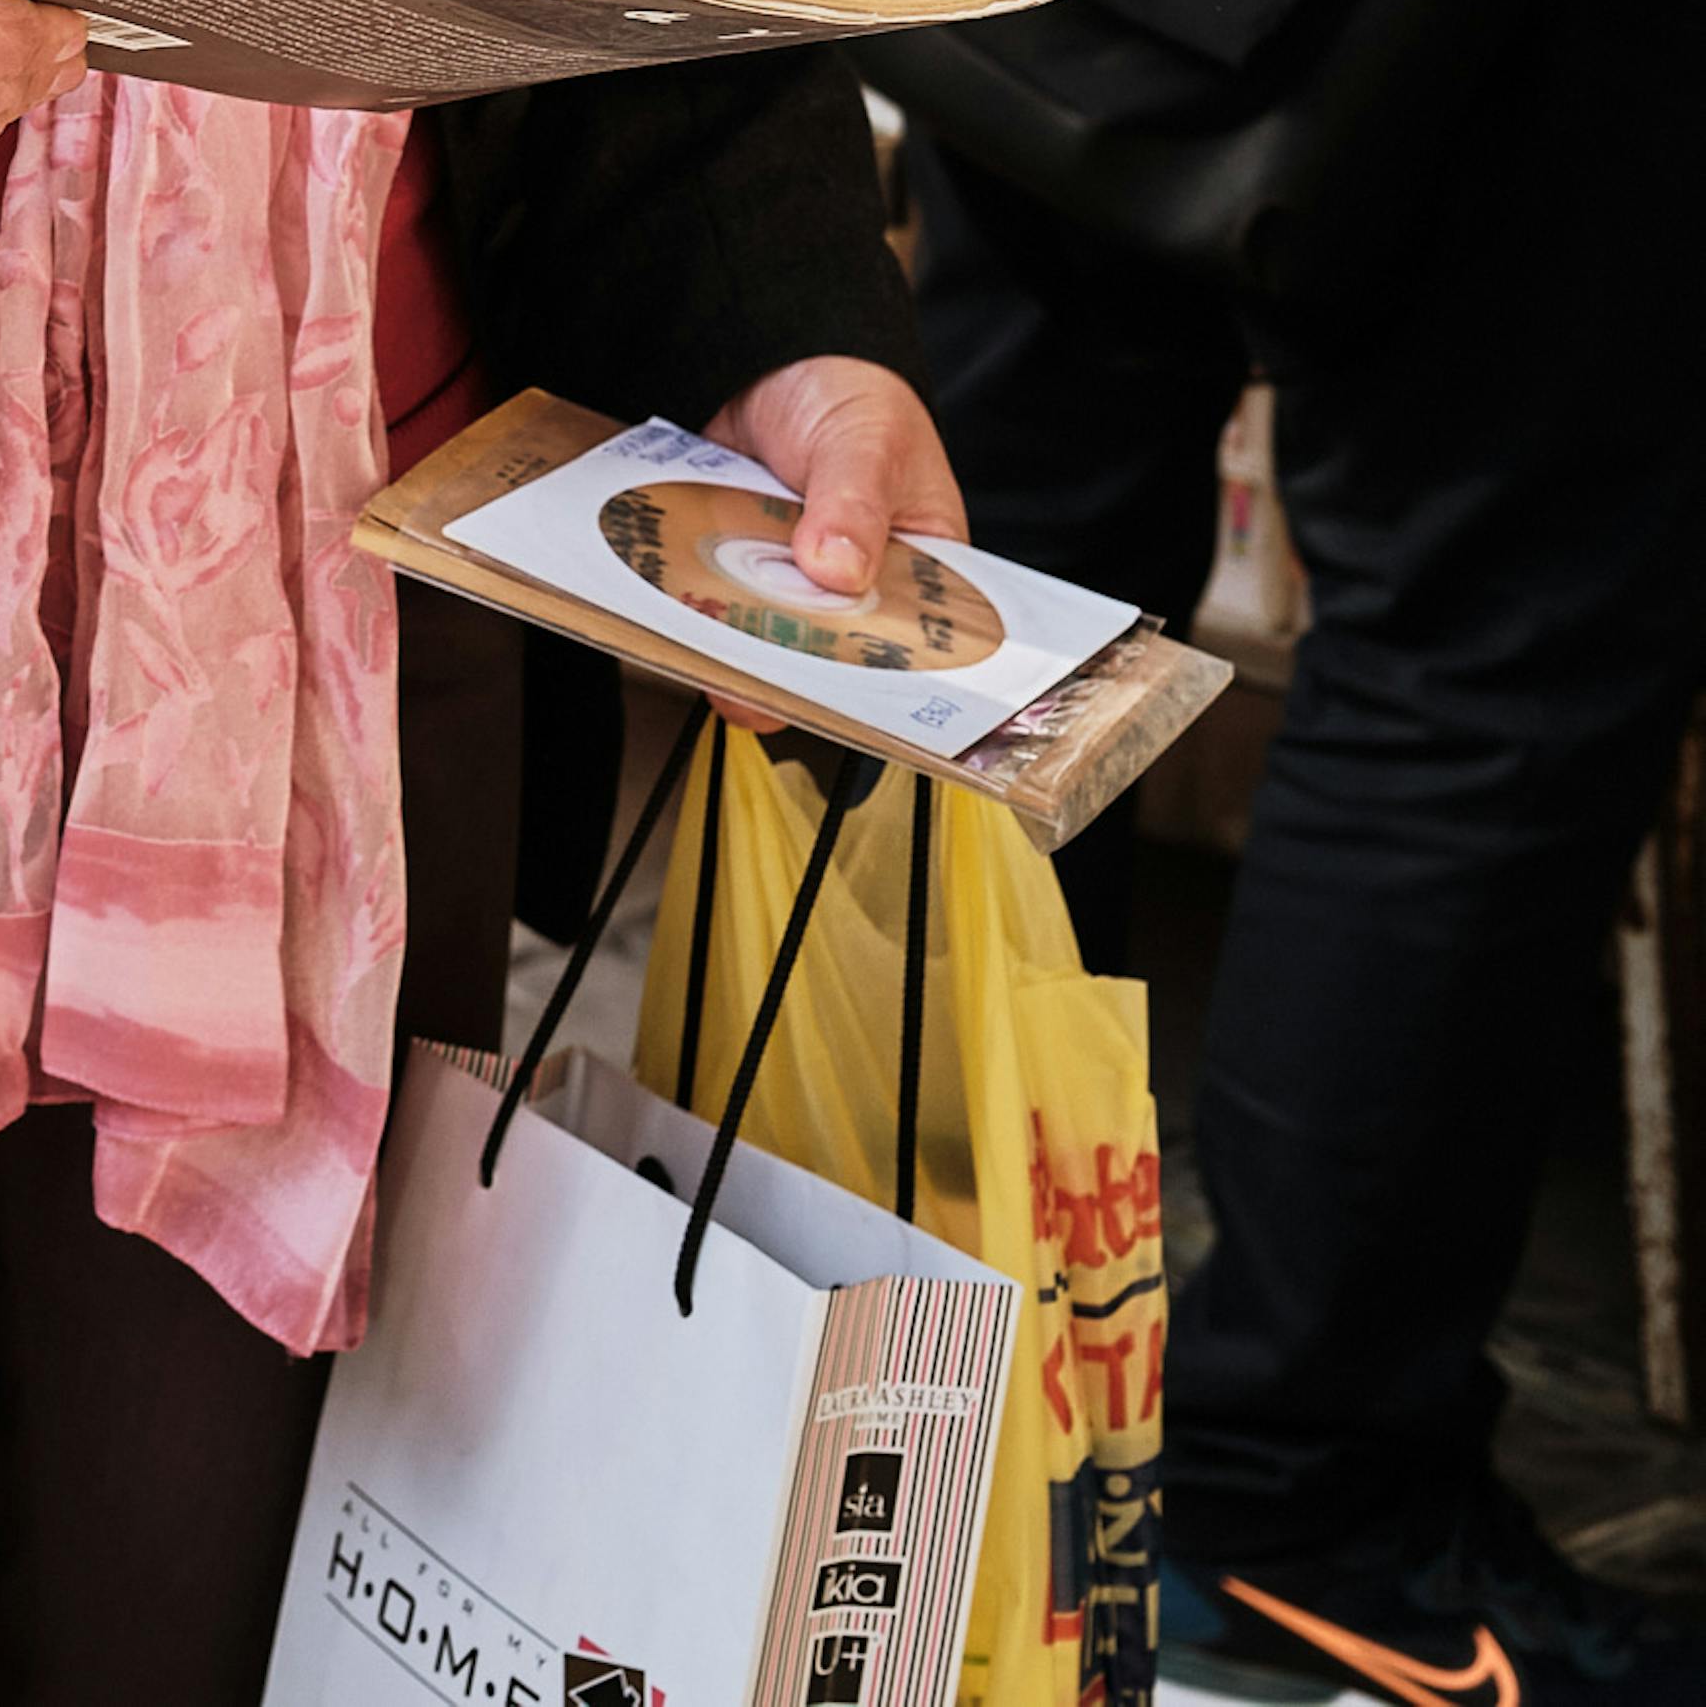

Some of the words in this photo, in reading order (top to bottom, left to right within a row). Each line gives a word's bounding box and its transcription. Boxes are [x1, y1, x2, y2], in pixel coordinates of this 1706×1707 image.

[876, 1386, 974, 1413] ASHLEY
[843, 1482, 886, 1519] sia
[342, 1500, 388, 1550] ALL
[418, 1562, 474, 1616] FOR
